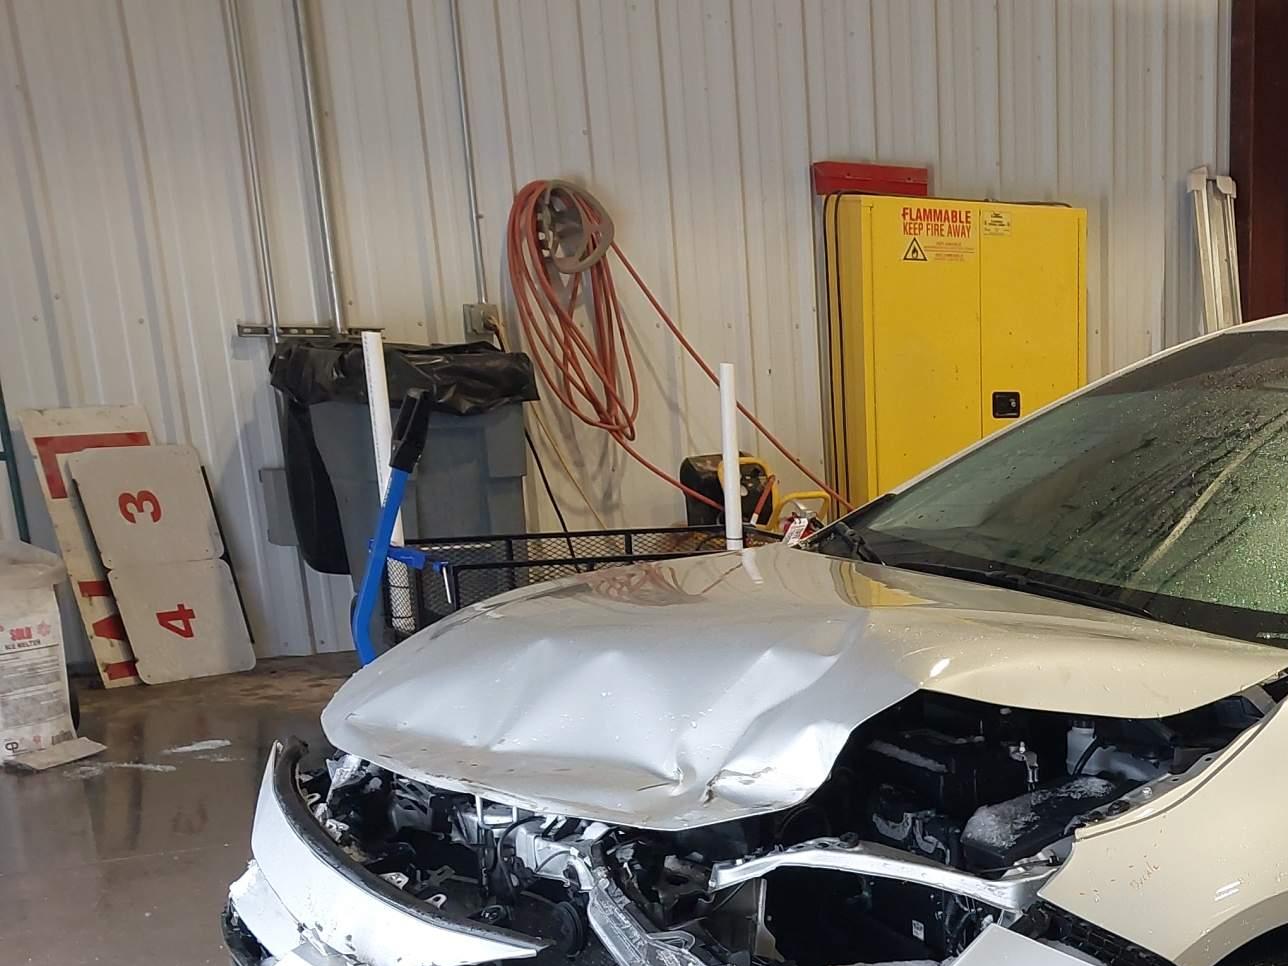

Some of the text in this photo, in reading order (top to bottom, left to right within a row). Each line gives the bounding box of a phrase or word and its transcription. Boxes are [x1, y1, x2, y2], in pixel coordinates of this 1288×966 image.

[902, 207, 971, 224] FLAMMABLE
[903, 222, 971, 238] KEEP FIRE AWAY
[118, 489, 162, 524] 3
[155, 603, 196, 638] 4
